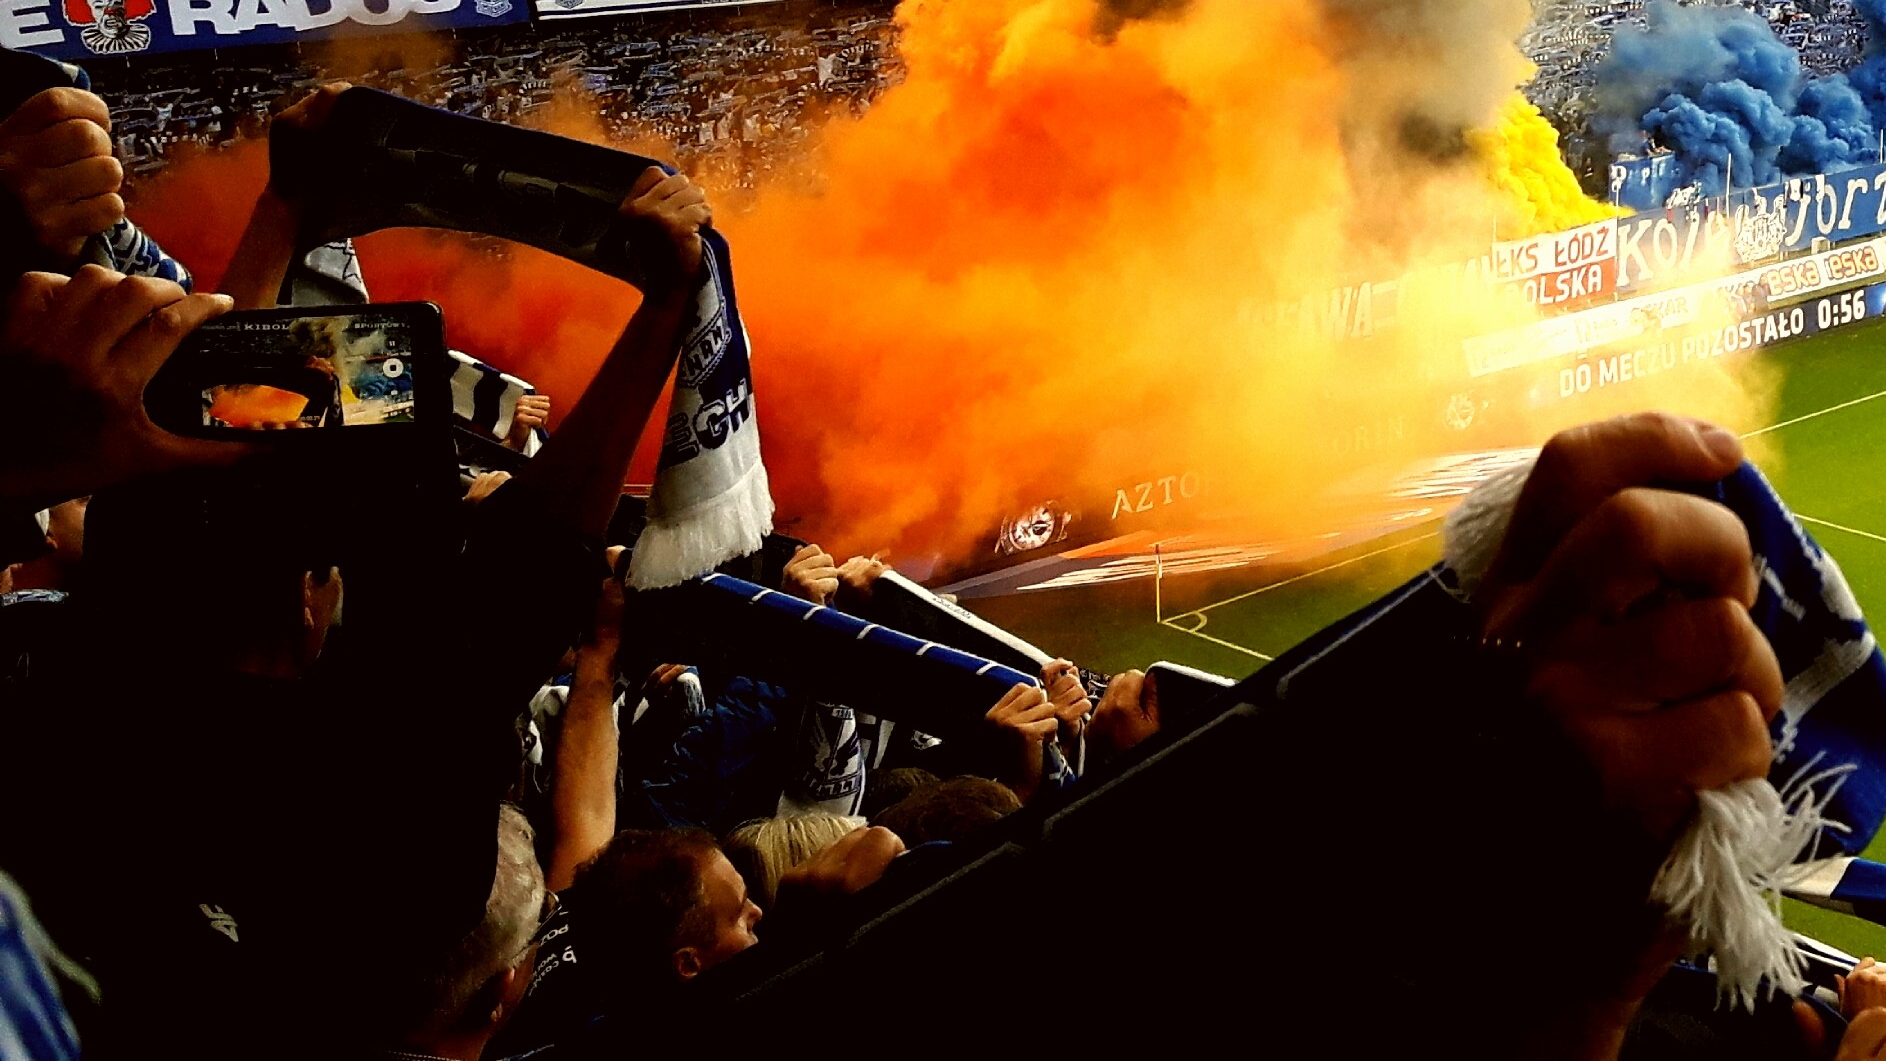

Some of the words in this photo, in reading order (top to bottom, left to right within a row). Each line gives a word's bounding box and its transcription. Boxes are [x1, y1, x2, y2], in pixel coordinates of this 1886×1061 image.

[1496, 242, 1539, 278] ŁKS
[1559, 364, 1592, 399] DO
[1599, 343, 1677, 388] MECZU
[1682, 308, 1804, 367] POZOSTAŁO
[1817, 290, 1866, 330] 0:56
